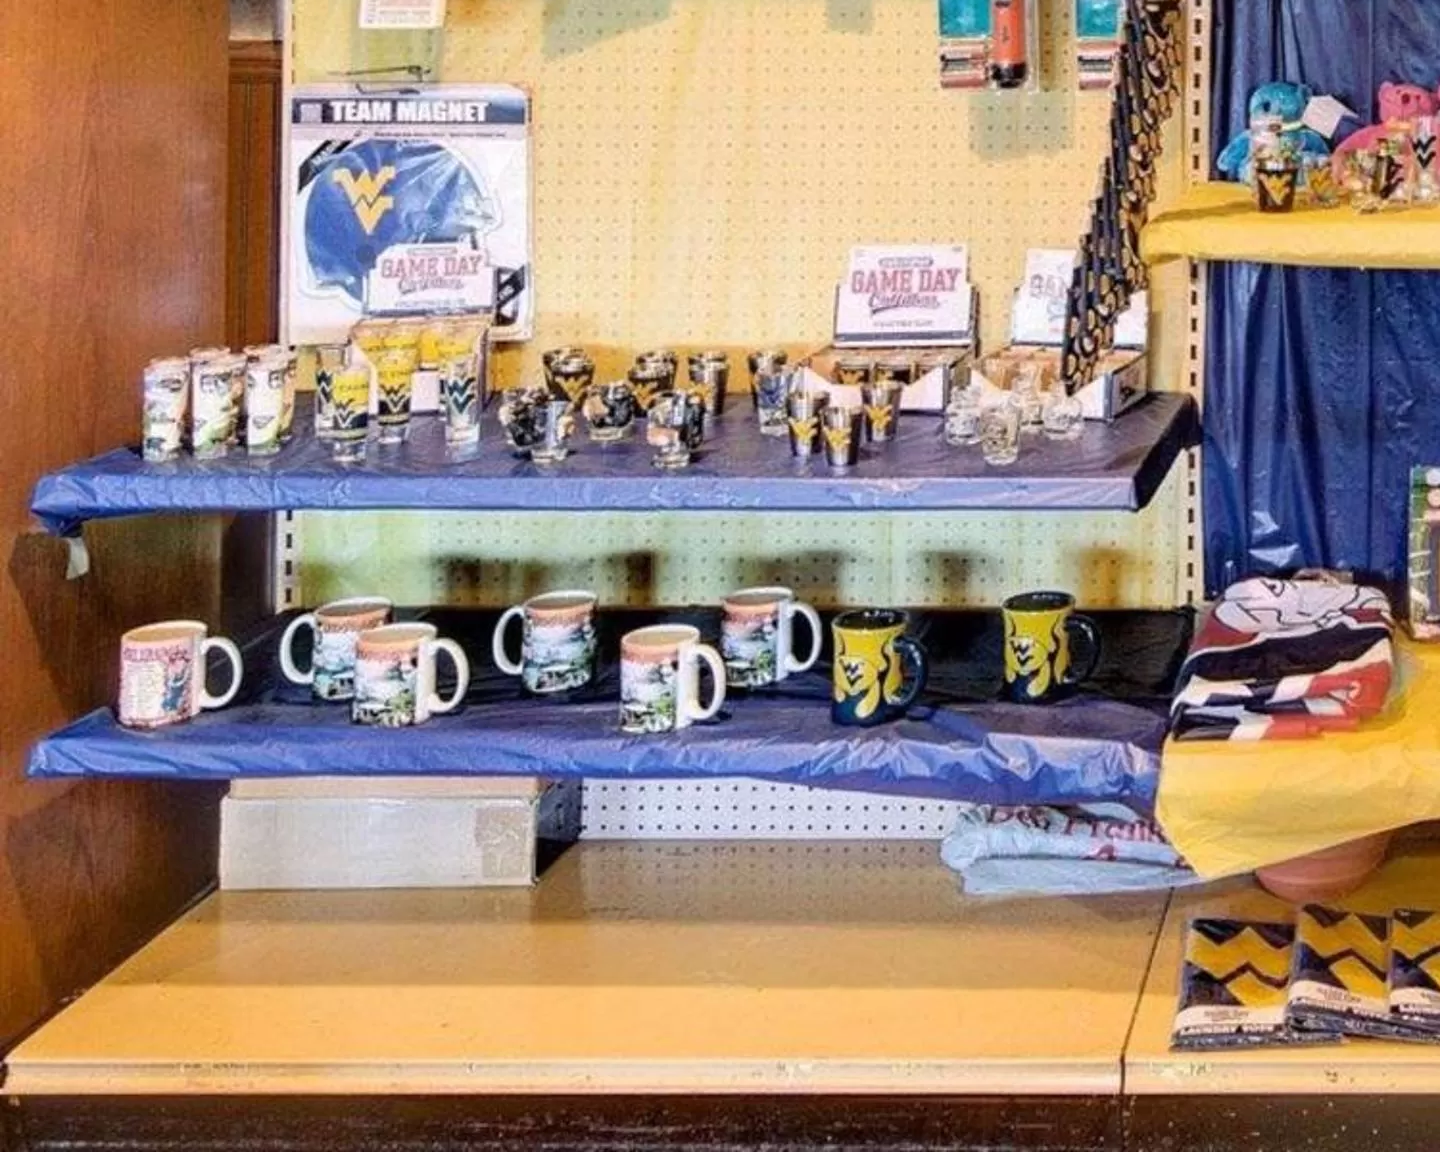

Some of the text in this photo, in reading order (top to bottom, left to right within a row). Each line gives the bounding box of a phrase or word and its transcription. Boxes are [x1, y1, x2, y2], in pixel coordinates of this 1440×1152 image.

[328, 100, 490, 123] TEAM MAGNET
[381, 254, 483, 279] GAME DAY
[851, 267, 962, 294] GAME DAY
